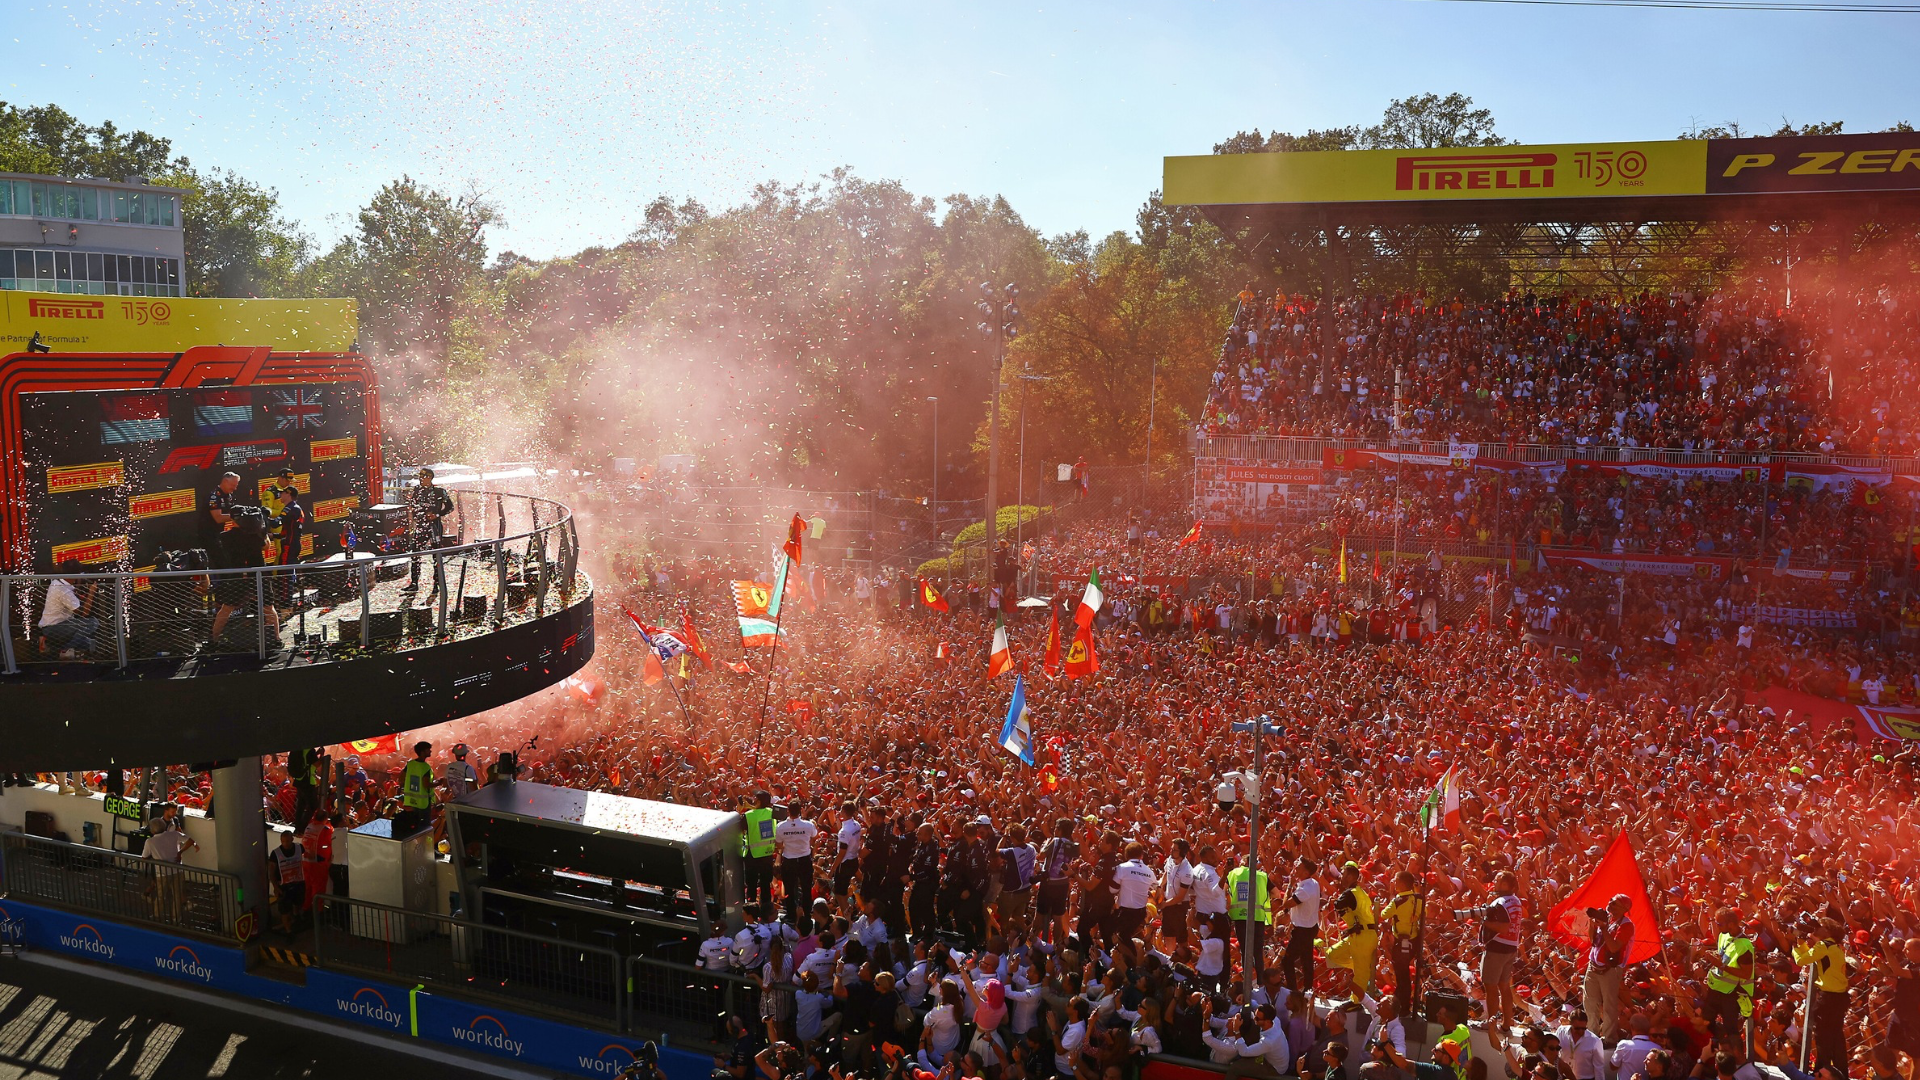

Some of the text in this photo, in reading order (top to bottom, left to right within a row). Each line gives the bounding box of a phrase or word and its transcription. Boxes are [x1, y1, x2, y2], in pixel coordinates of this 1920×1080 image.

[1396, 151, 1647, 190] PIRELLI 150
[1722, 154, 1775, 177] P
[29, 299, 170, 326] PIRELLI 150
[7, 335, 35, 343] Partne
[51, 469, 98, 486] PIRELLI
[1230, 470, 1254, 479] JULES
[132, 497, 173, 514] PIRELLI
[106, 797, 140, 818] GEORGE
